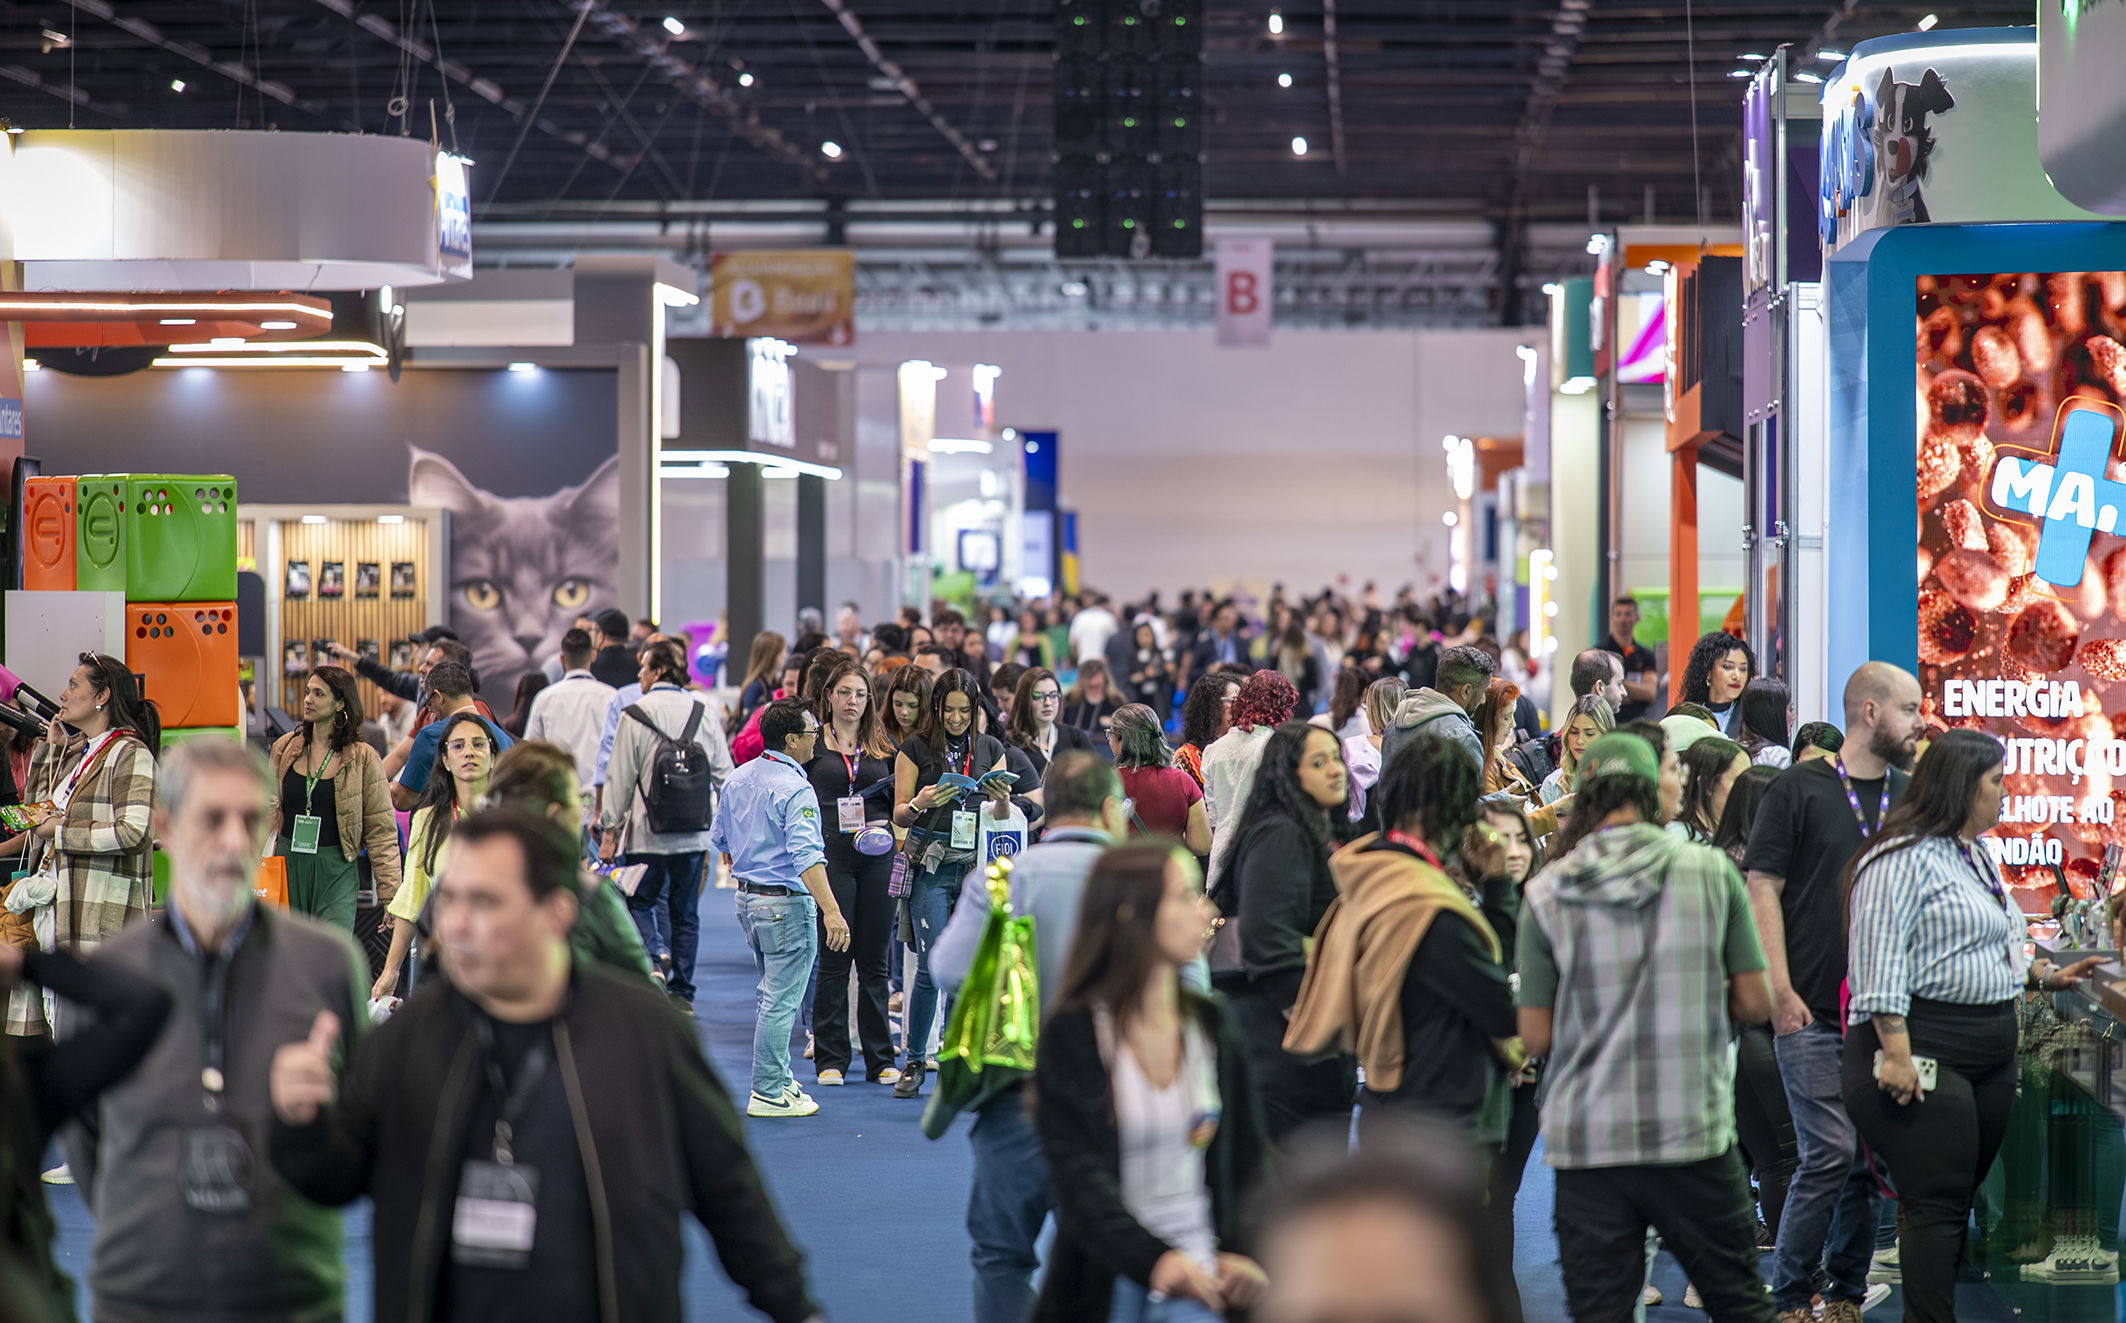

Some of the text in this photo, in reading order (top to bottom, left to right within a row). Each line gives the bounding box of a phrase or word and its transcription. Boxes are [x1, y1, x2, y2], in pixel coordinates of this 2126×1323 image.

[1227, 271, 1259, 315] B
[0, 404, 22, 437] ntares
[1944, 679, 2084, 718] ENERGIA
[1997, 731, 2126, 786] UTRIÇÃO
[1999, 795, 2115, 825] LHOTE AO
